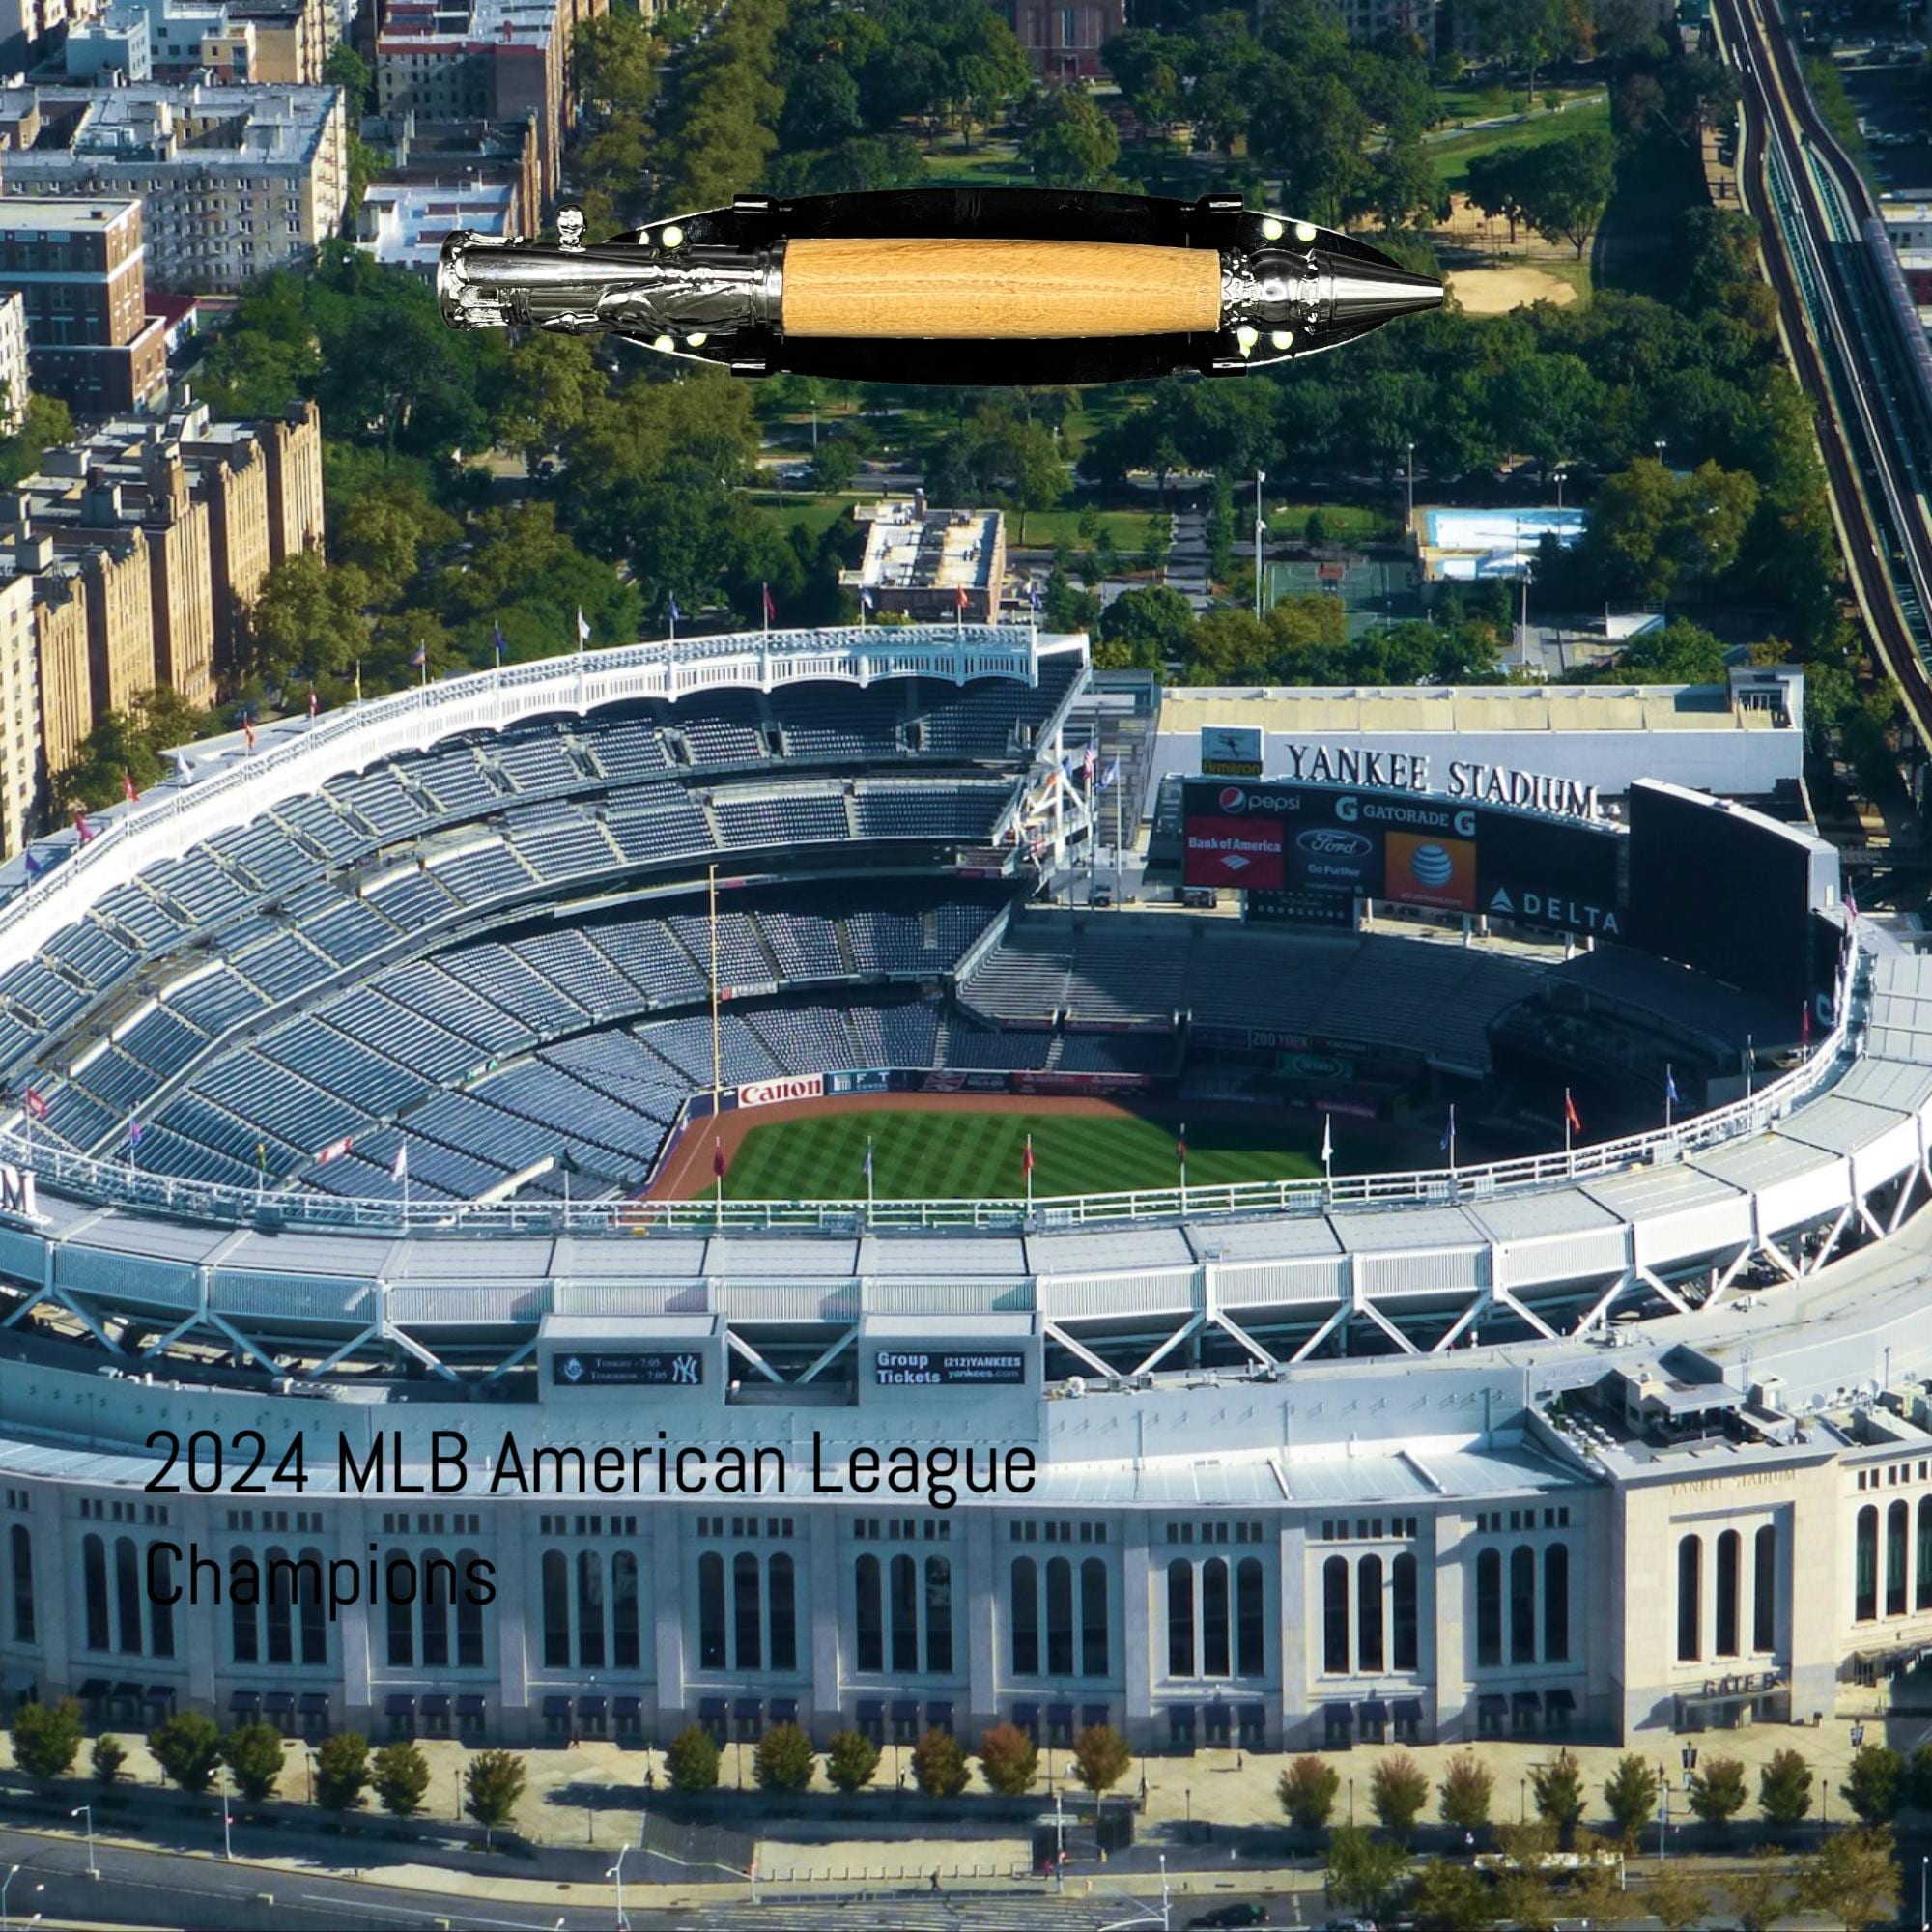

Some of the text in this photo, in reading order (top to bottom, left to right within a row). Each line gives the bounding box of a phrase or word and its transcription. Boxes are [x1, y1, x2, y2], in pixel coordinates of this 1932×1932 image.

[1285, 744, 1599, 819] YANKEE STADIUM
[1248, 795, 1301, 812] pepsi
[1334, 796, 1476, 838] G GATORADE G
[1187, 837, 1282, 853] Bank of America
[1310, 833, 1357, 855] Ford
[1523, 893, 1620, 935] DELTA
[740, 1079, 821, 1104] Canon
[877, 1352, 928, 1370] Group
[877, 1370, 941, 1383] Tickets
[1703, 1674, 1754, 1698] GATE
